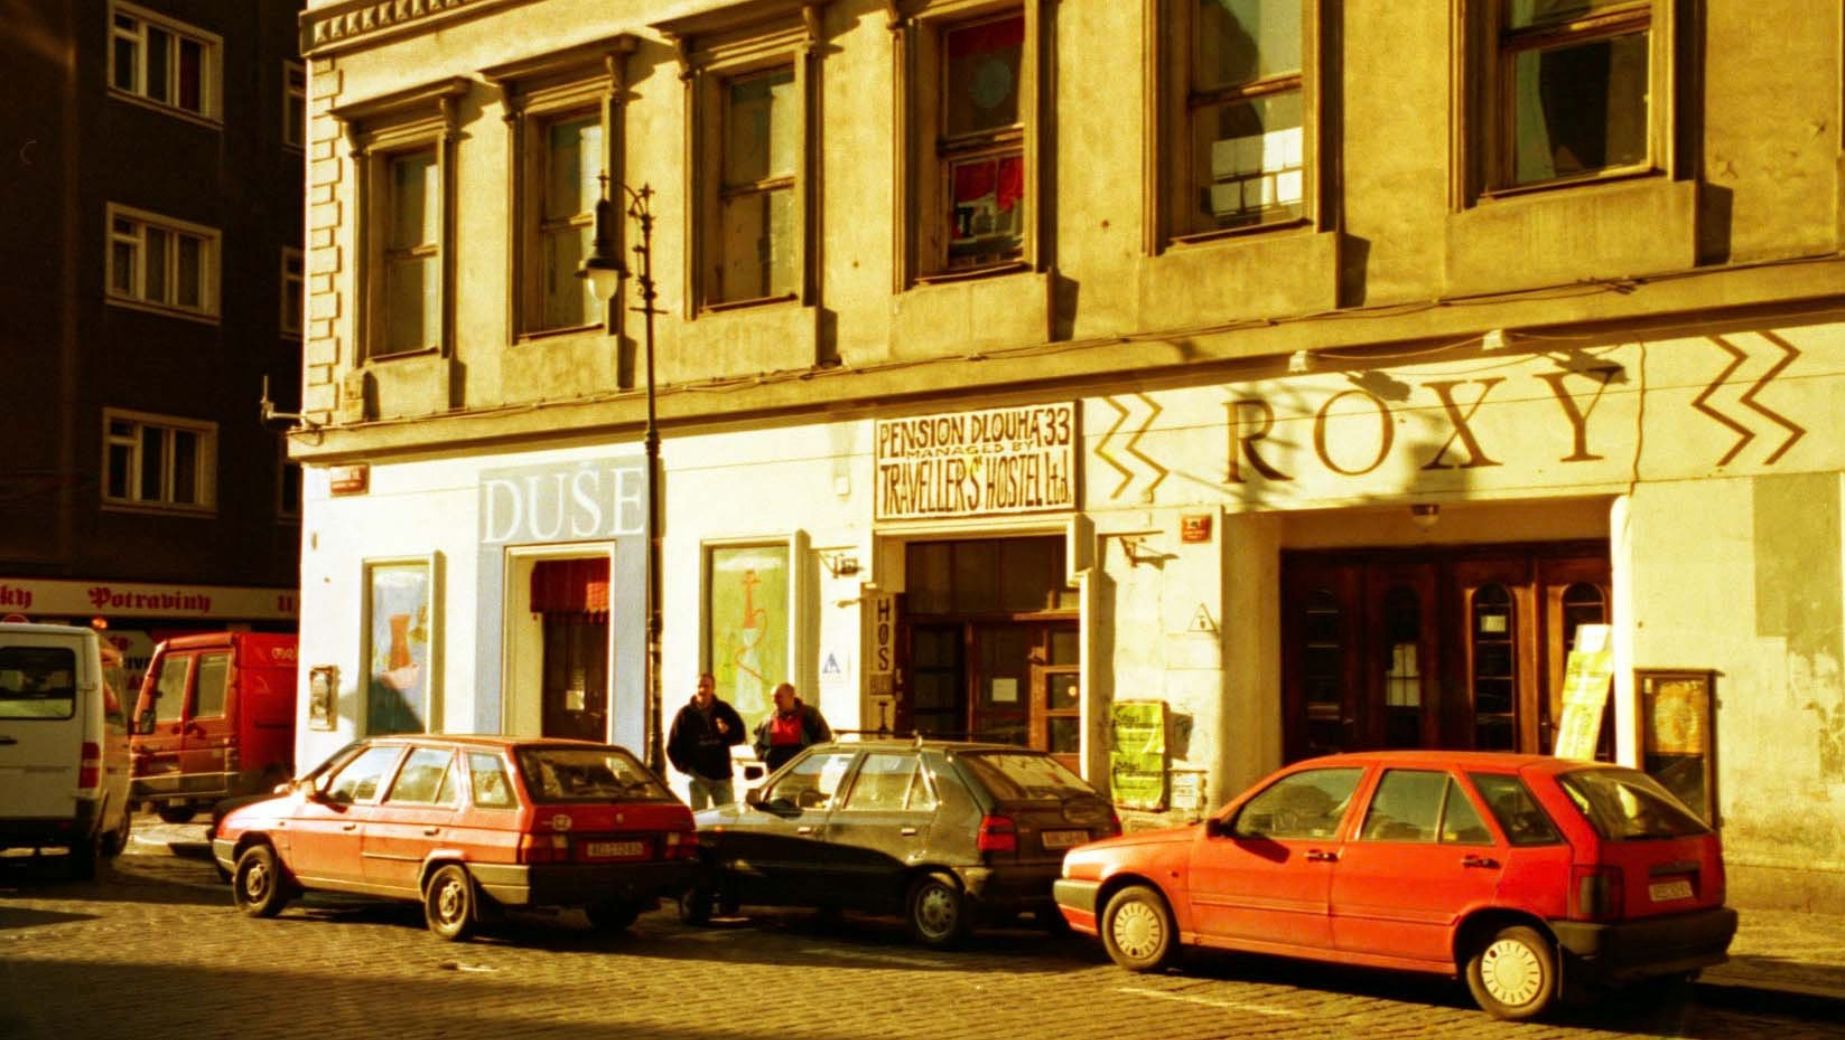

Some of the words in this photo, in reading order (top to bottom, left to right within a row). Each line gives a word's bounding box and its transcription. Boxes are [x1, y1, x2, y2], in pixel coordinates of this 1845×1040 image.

[879, 415, 965, 459] PENSION
[1044, 407, 1071, 446] 33
[906, 443, 1004, 458] MANAGED
[1011, 439, 1033, 452] BY
[1222, 366, 1625, 484] ROXY
[480, 460, 646, 544] DUŠE
[985, 453, 1043, 509] HOSTEL
[87, 586, 211, 614] Potraviny
